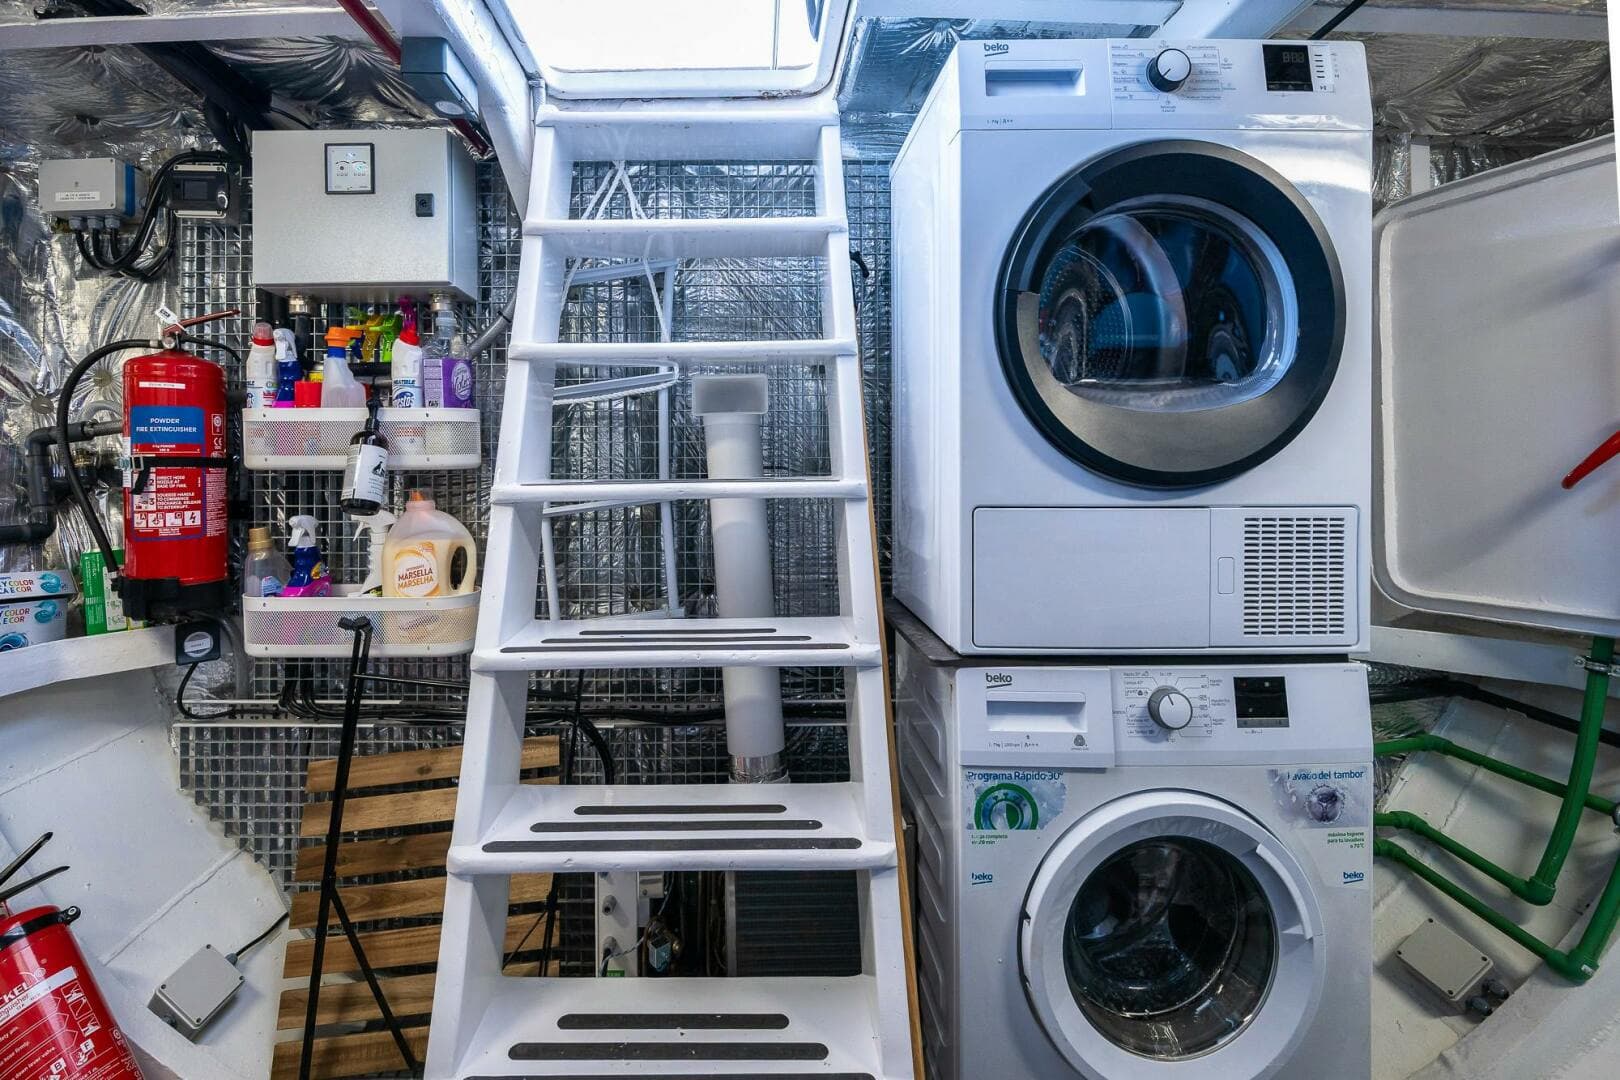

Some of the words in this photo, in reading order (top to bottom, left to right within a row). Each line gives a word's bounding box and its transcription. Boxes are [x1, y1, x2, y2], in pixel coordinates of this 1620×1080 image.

[984, 43, 1009, 51] beko
[398, 567, 433, 581] MARSELLA
[8, 579, 34, 587] COLOR
[398, 575, 434, 589] MARSELHA
[4, 608, 30, 617] COLOR
[985, 672, 1013, 683] beko
[967, 771, 1012, 782] Programa
[1013, 771, 1047, 782] Rápido
[1318, 771, 1331, 780] del
[1334, 770, 1364, 779] tambor
[971, 872, 993, 881] beko
[1343, 871, 1364, 880] beko
[84, 1041, 90, 1050] F
[54, 1061, 62, 1071] B
